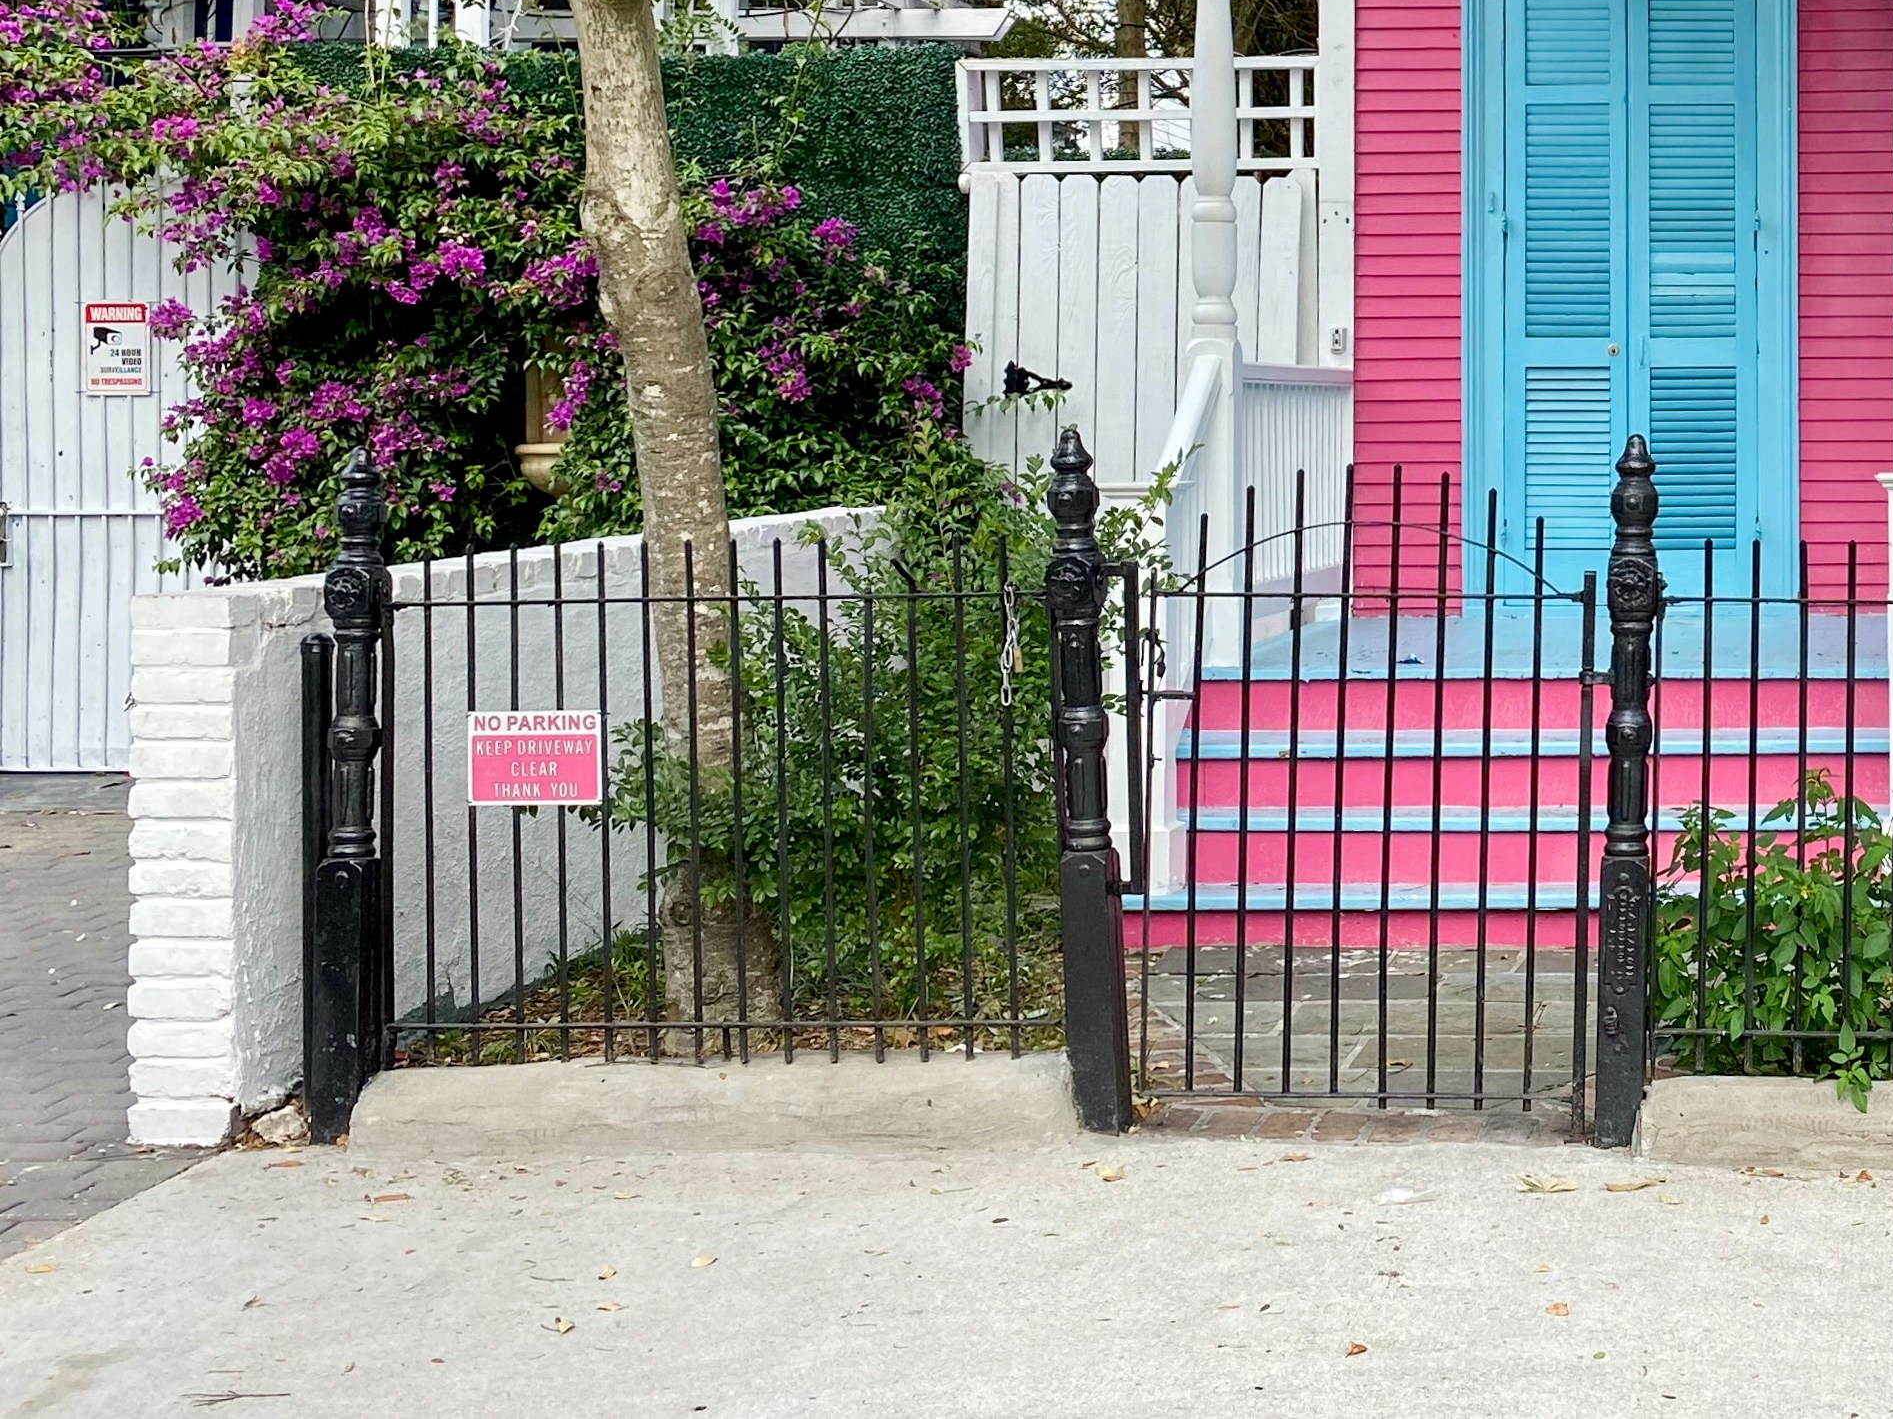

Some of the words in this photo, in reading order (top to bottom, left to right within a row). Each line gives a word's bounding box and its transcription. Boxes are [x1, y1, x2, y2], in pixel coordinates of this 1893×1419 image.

[90, 306, 143, 321] WARNING
[110, 349, 119, 357] 24
[474, 715, 501, 731] NO
[507, 714, 597, 731] PARKING
[476, 740, 513, 756] KEEP
[517, 739, 593, 755] DRIVEWAY
[511, 761, 558, 777] CLEAR
[493, 782, 541, 798] THANK
[550, 782, 578, 797] YOU
